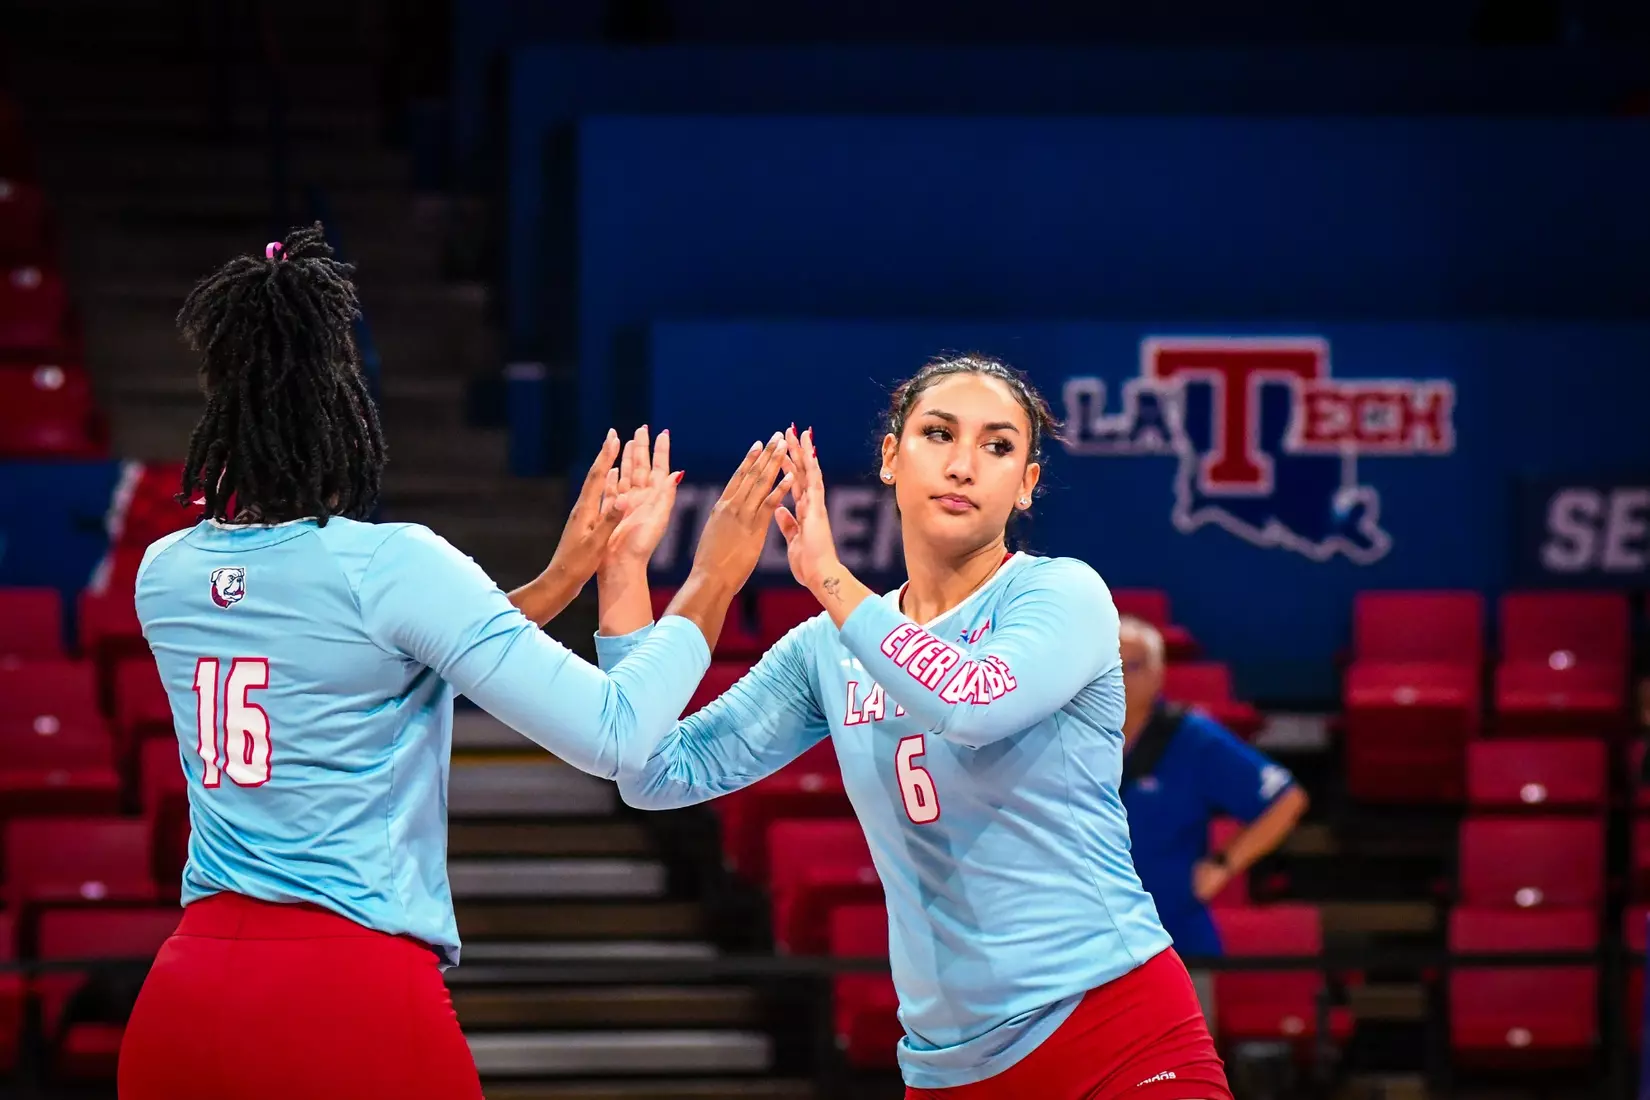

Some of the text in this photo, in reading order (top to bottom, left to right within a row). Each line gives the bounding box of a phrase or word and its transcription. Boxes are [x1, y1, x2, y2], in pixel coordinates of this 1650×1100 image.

[880, 622, 961, 691] EVER
[192, 657, 272, 788] 16
[844, 681, 886, 726] LA
[895, 734, 940, 824] 6
